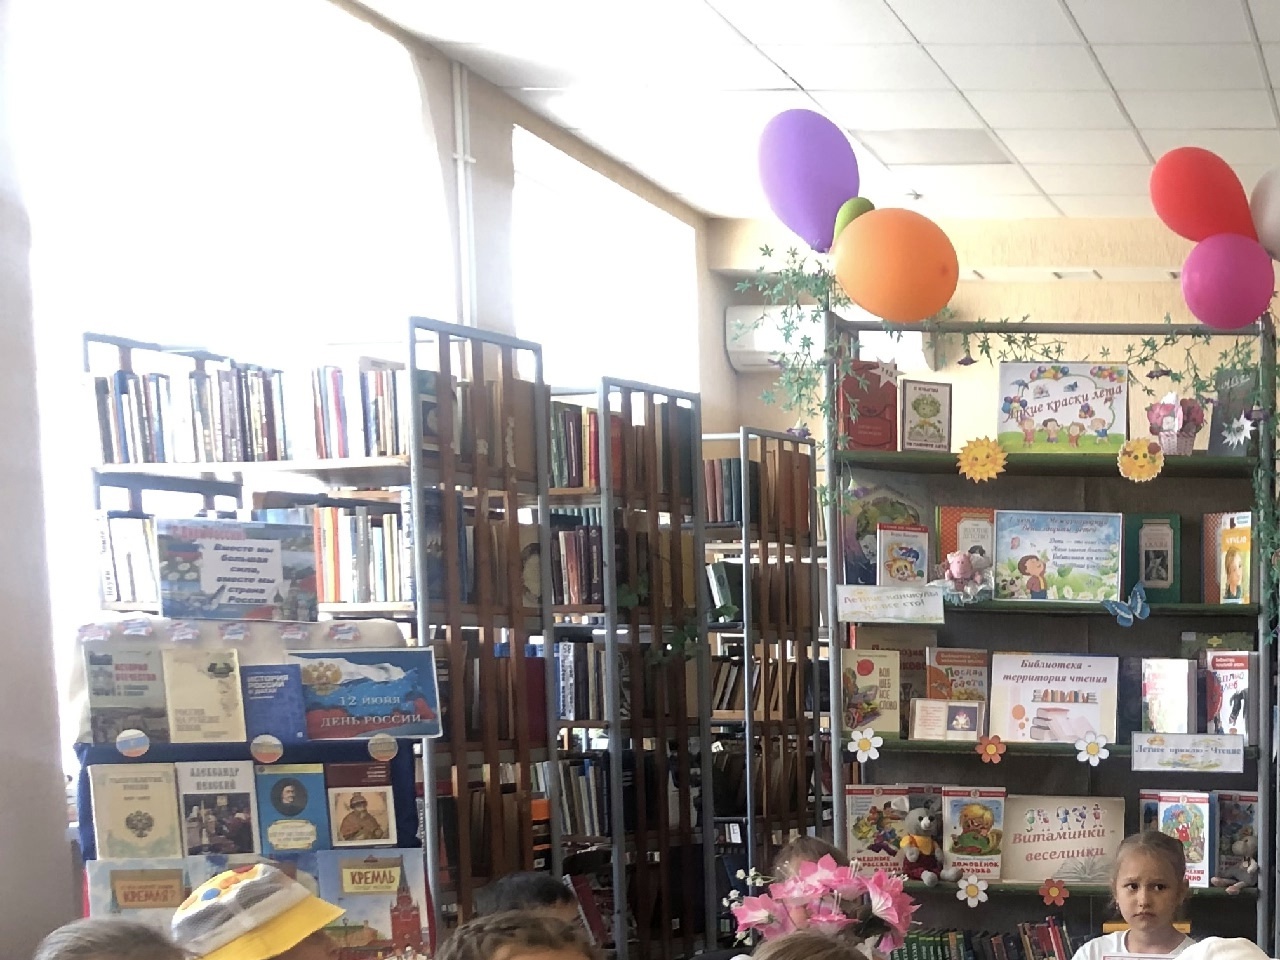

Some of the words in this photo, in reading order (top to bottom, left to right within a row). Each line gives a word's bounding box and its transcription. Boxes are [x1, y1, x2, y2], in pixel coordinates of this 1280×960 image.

[1046, 393, 1089, 413] краски
[1092, 385, 1123, 400] лета
[214, 543, 254, 552] Вместе
[221, 554, 269, 563] большая
[1020, 659, 1083, 670] Библиотека
[1003, 673, 1066, 684] территория
[1069, 675, 1107, 684] чтения
[340, 696, 357, 706] 12
[362, 696, 400, 705] июня
[321, 716, 360, 728] ДЕНЬ
[364, 714, 421, 725] РОССИИ
[1210, 746, 1241, 755] Чтение
[190, 767, 239, 777] АЛЕКСАНДР
[1012, 828, 1105, 845] Витаминки
[1025, 847, 1106, 861] веселинки
[350, 871, 395, 885] КРЕМЛЬ
